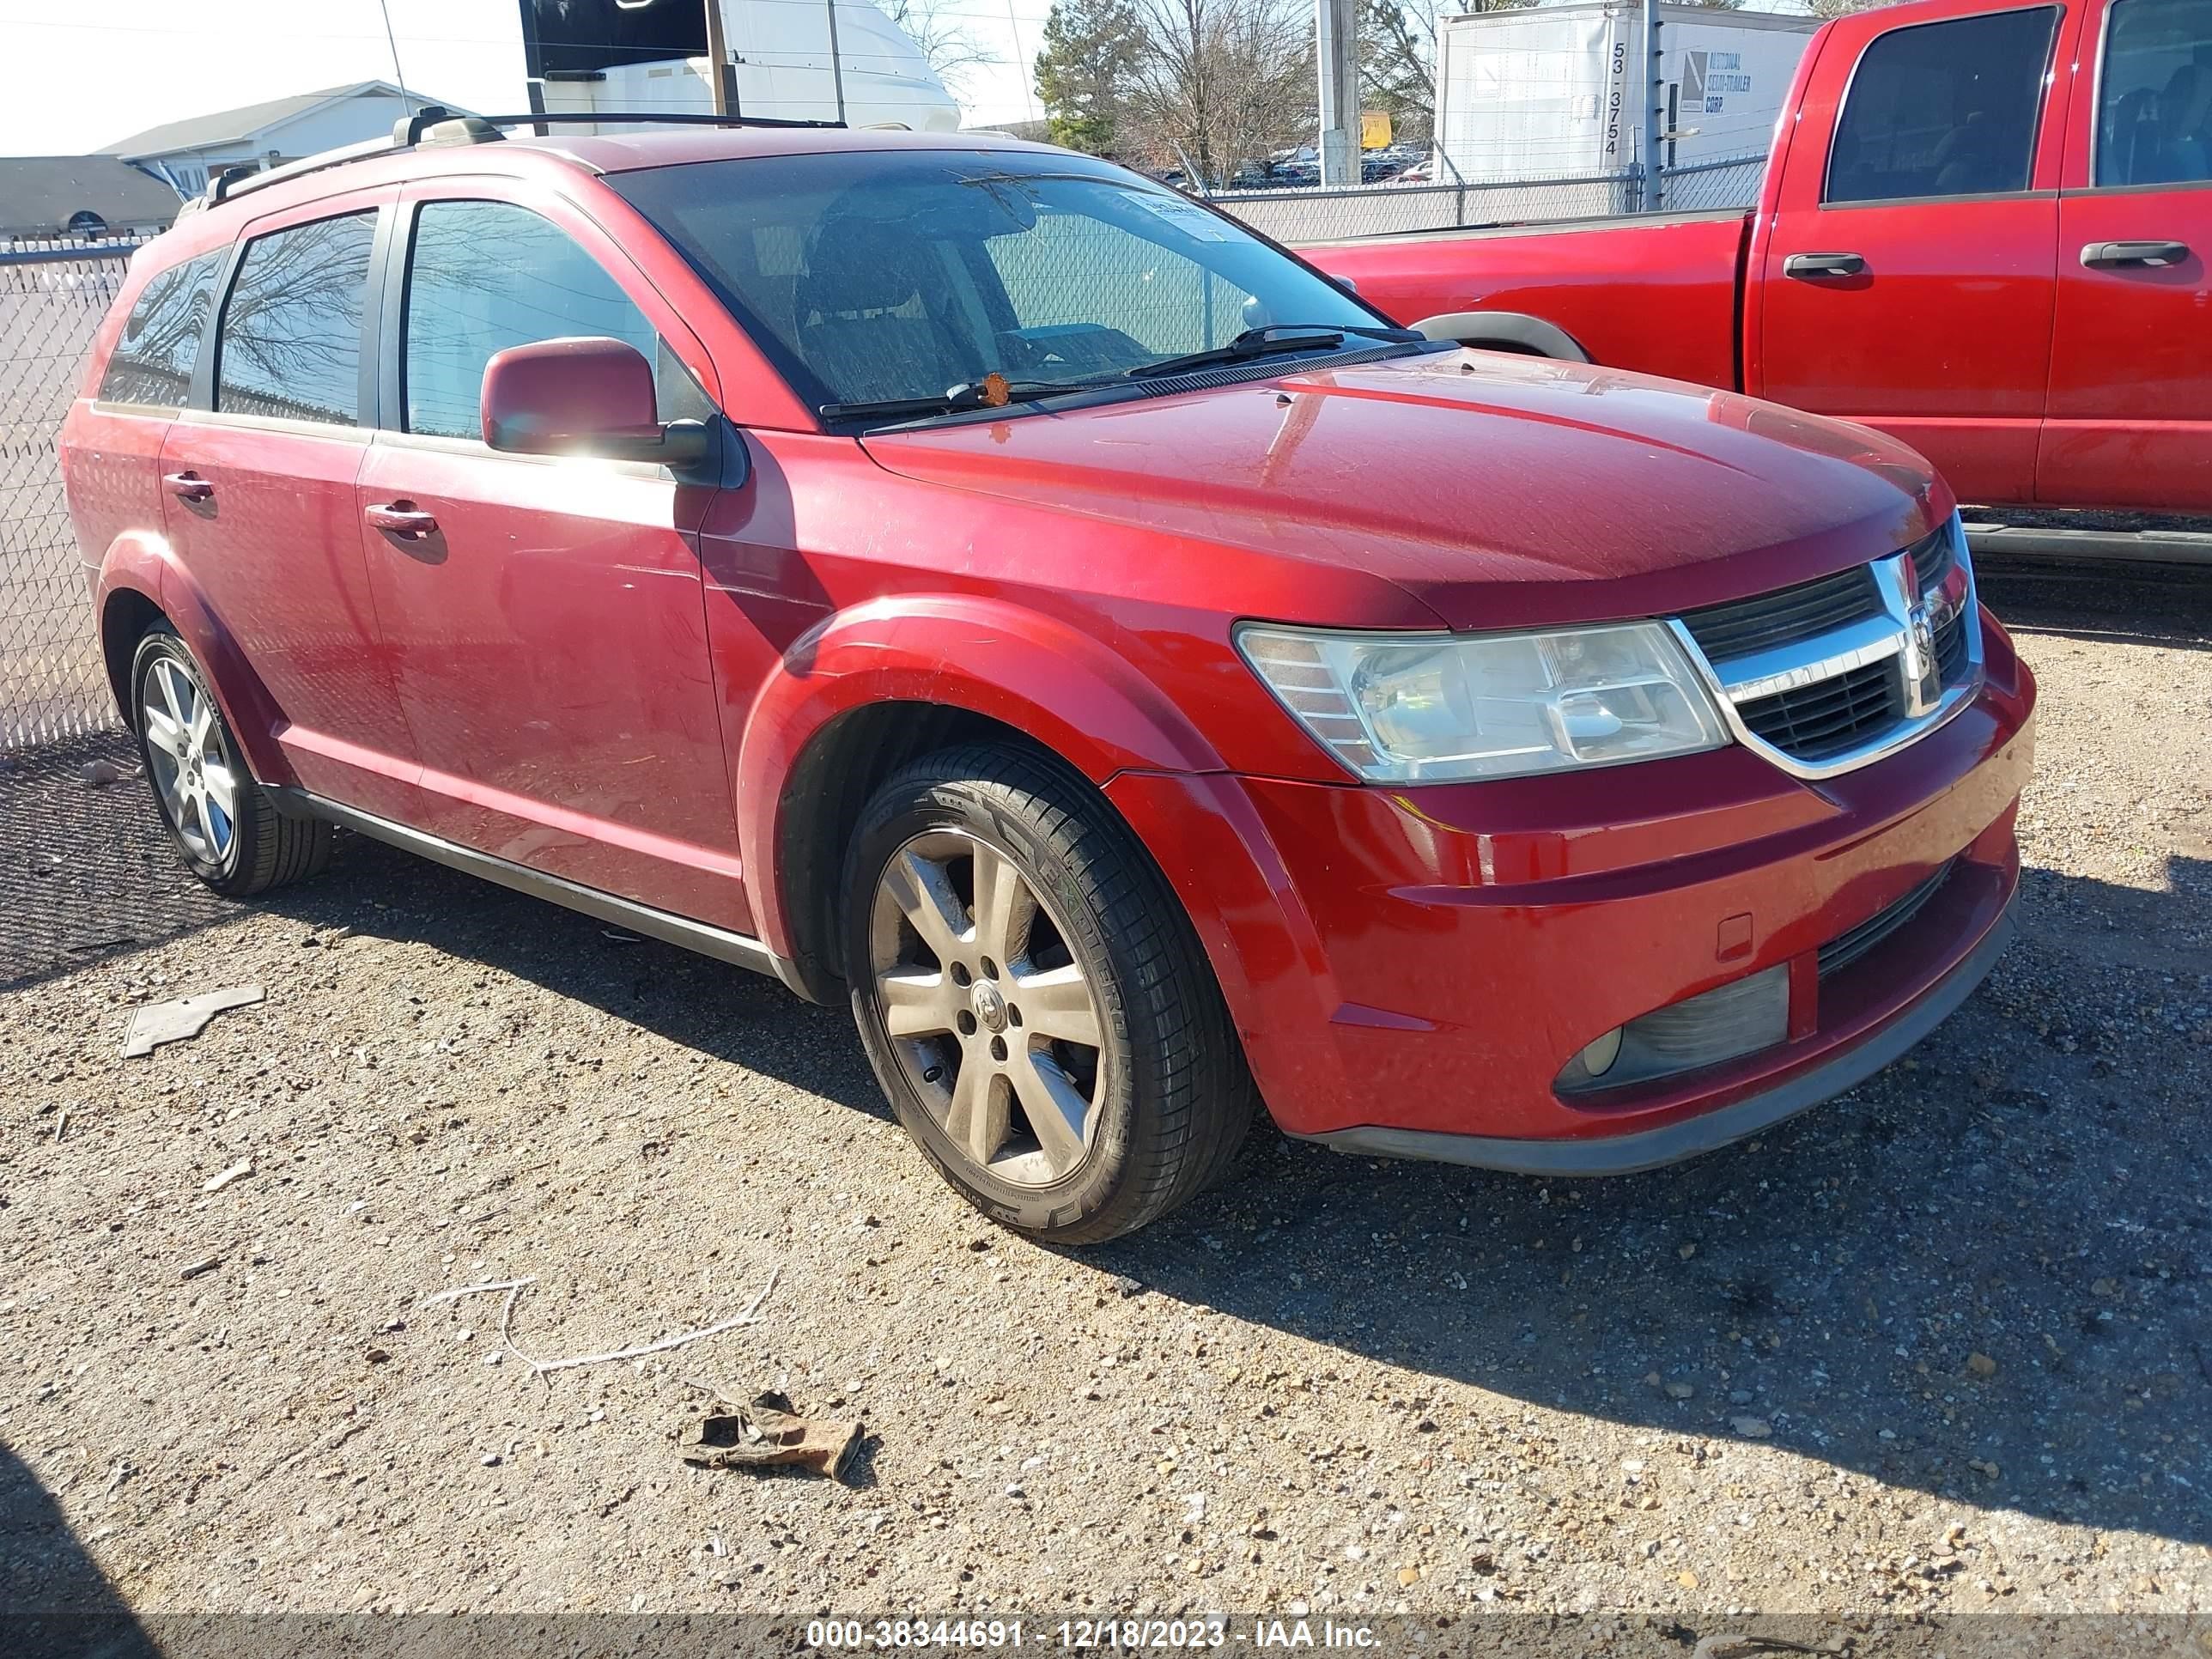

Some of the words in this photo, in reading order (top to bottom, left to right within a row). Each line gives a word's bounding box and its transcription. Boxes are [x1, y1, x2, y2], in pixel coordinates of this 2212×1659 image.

[1709, 52, 1741, 70] NATIONAL
[1605, 42, 1625, 155] 53-3754
[1705, 95, 1724, 113] CORP.
[951, 1178, 983, 1210] OUTSIDE
